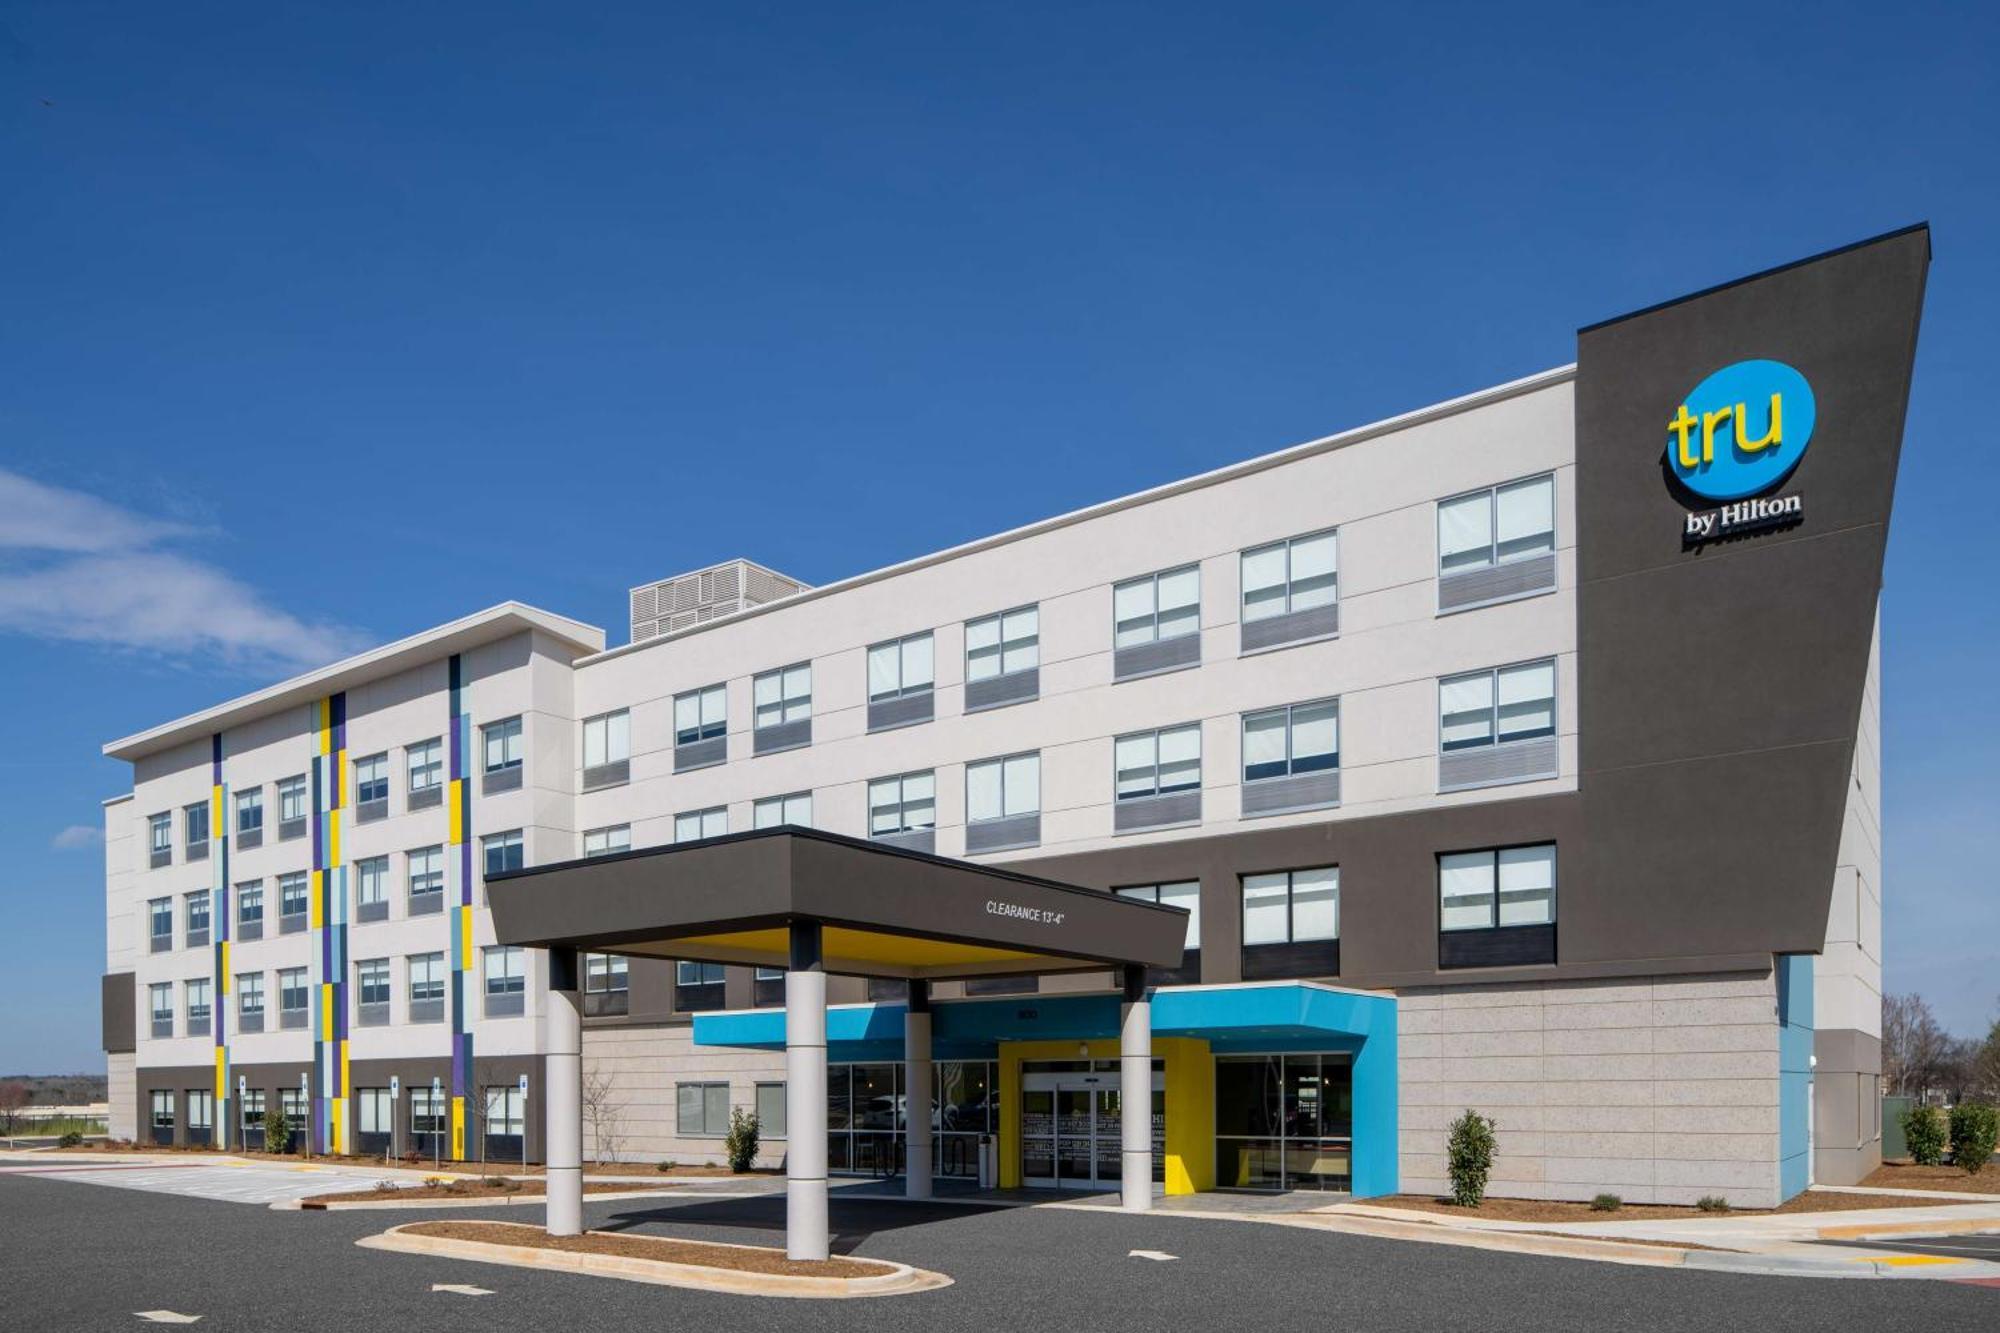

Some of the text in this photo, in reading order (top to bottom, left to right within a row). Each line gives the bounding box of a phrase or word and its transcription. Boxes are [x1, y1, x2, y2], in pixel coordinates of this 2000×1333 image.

[1667, 392, 1783, 469] tru
[1686, 495, 1801, 535] by Hilton
[986, 900, 1041, 921] CLEARANCE
